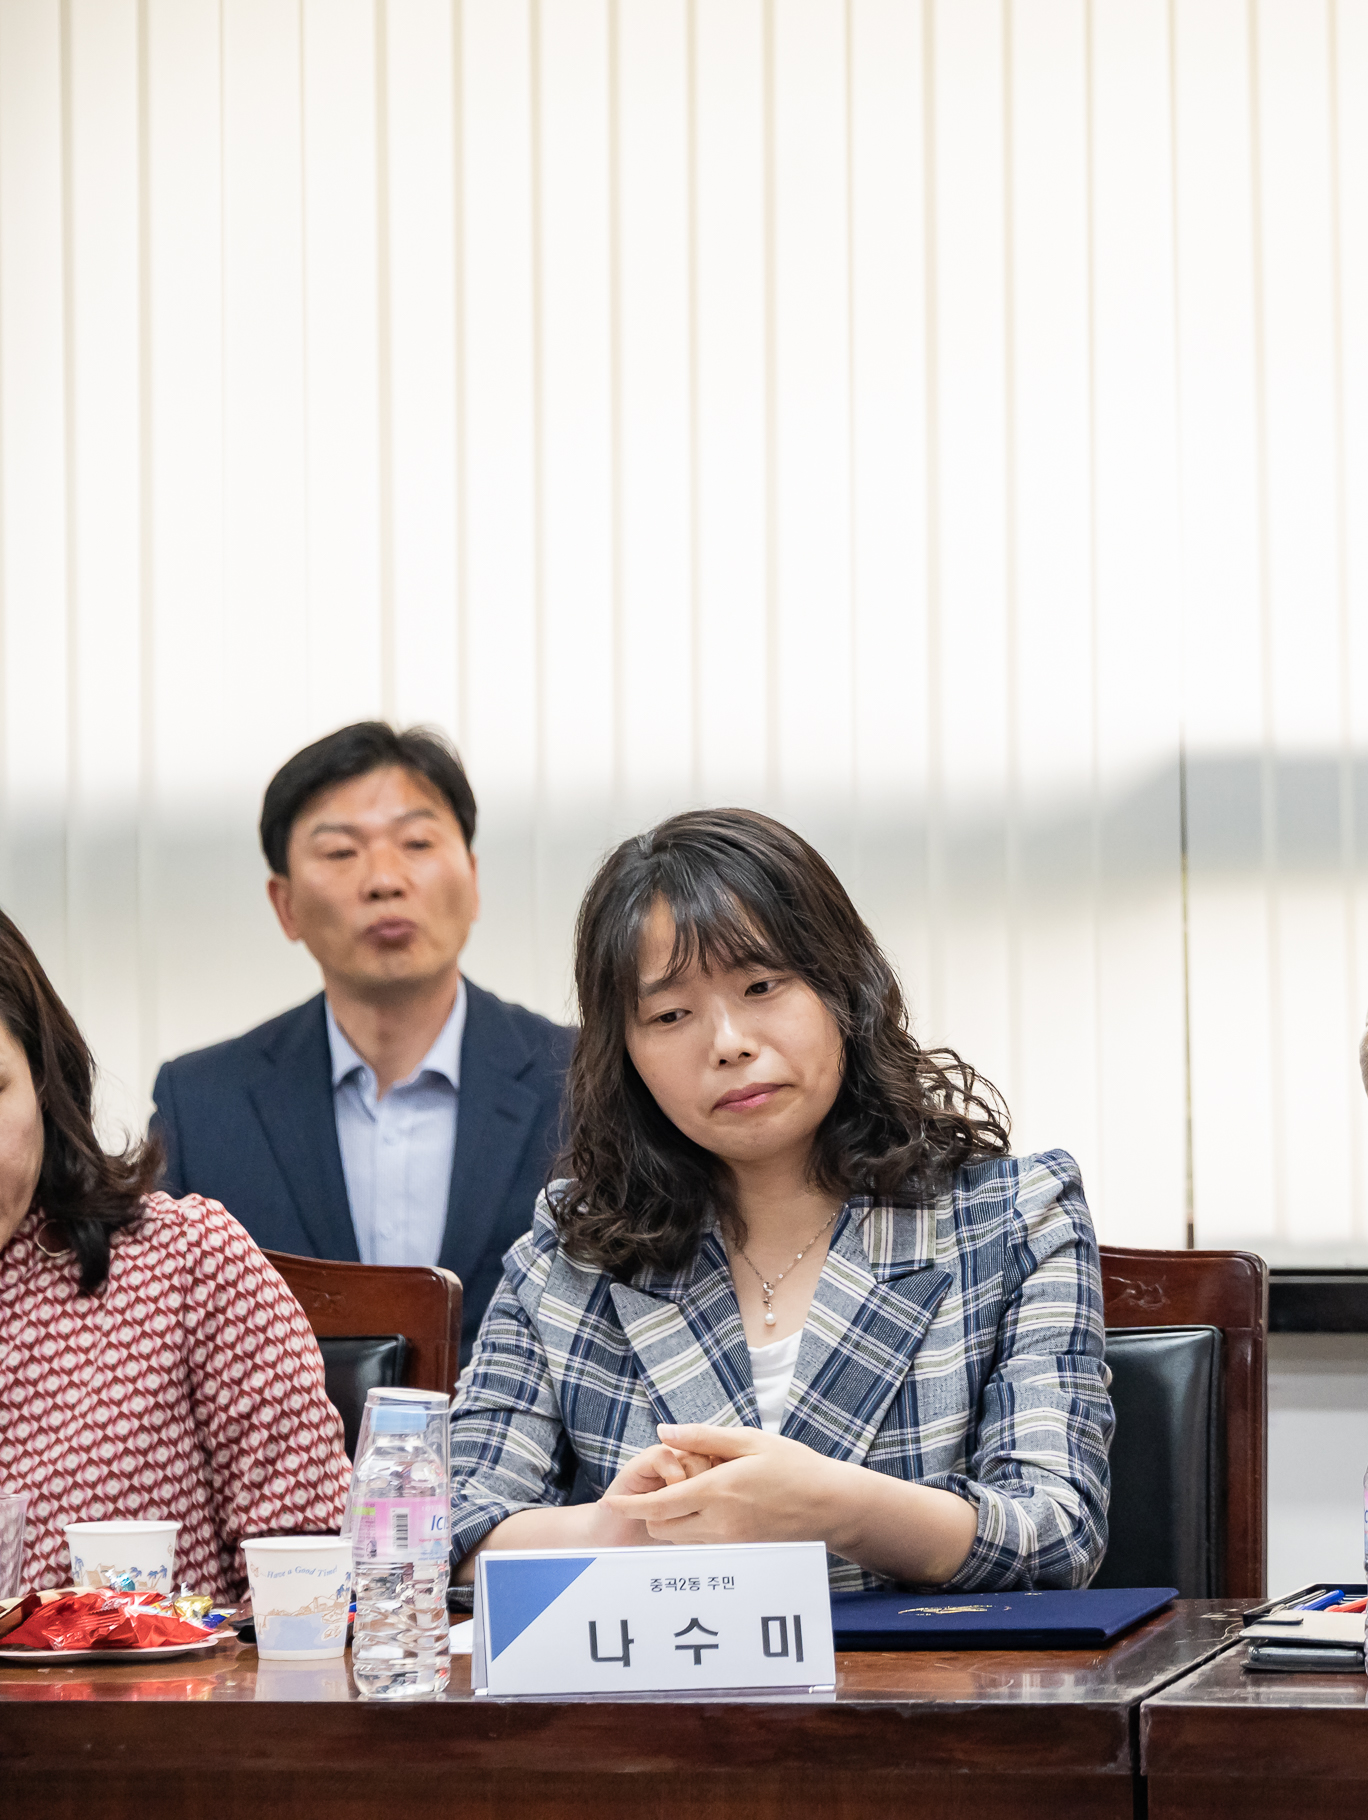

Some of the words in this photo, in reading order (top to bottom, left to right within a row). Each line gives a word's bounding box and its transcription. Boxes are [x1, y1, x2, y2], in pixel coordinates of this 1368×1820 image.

[266, 1570, 286, 1579] Have
[295, 1565, 316, 1575] Good
[650, 1576, 701, 1593] 중곡2동
[706, 1575, 736, 1591] 주민
